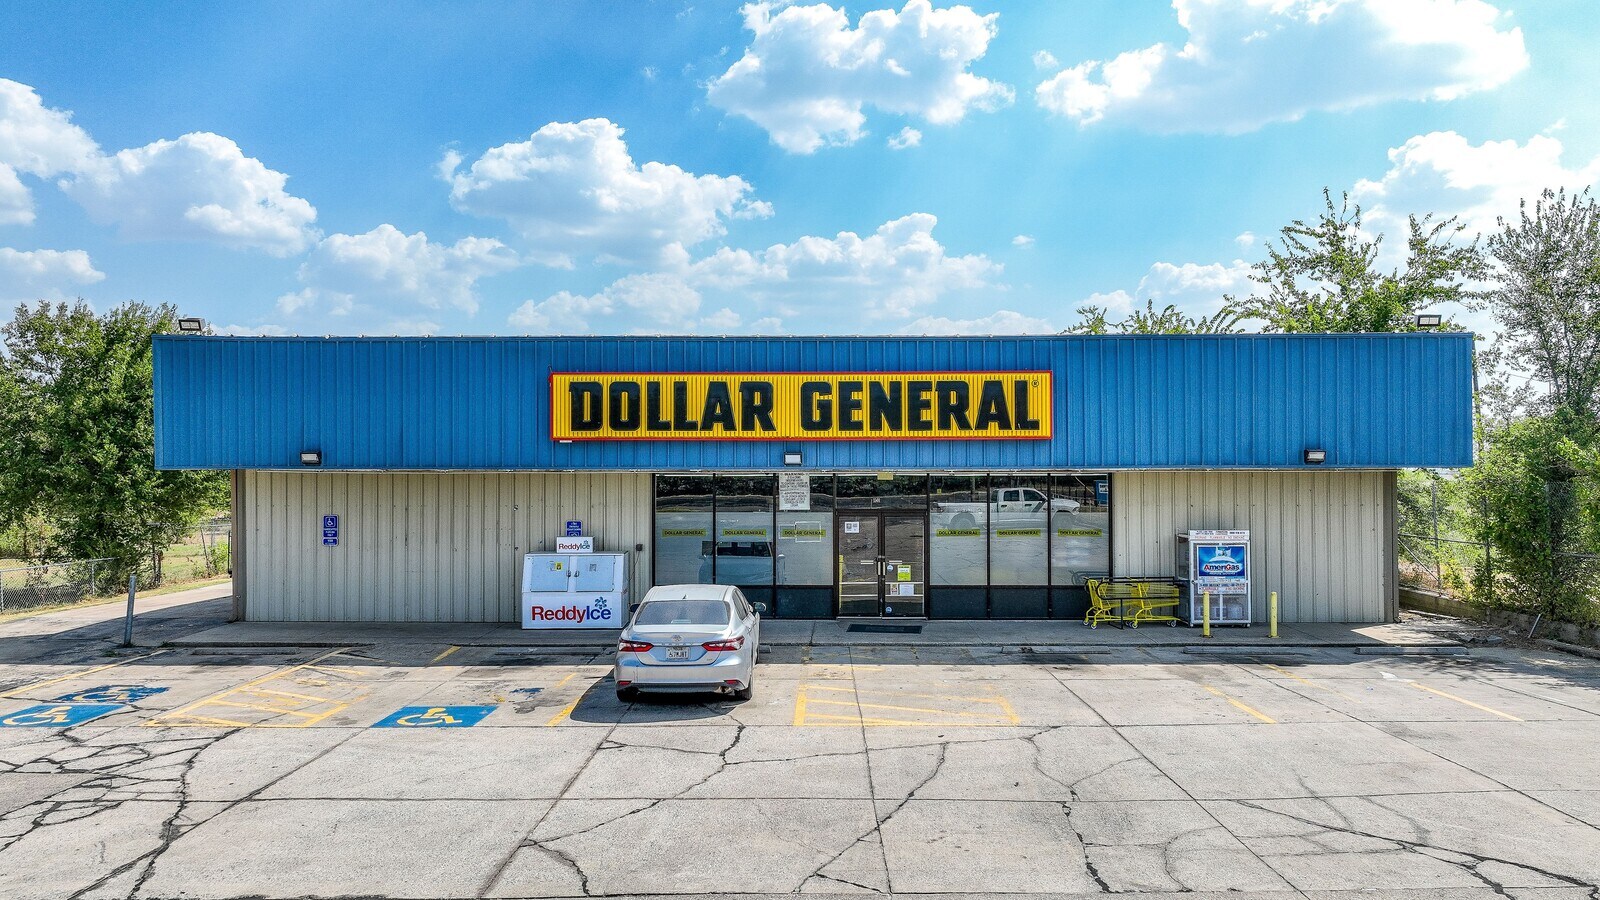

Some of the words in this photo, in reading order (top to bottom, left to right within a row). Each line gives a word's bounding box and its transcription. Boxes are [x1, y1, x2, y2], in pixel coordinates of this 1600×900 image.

[569, 380, 777, 432] DOLLAR
[799, 379, 1041, 432] GENERAL
[1203, 563, 1240, 571] AmeriGas
[531, 605, 612, 624] ReddyIce
